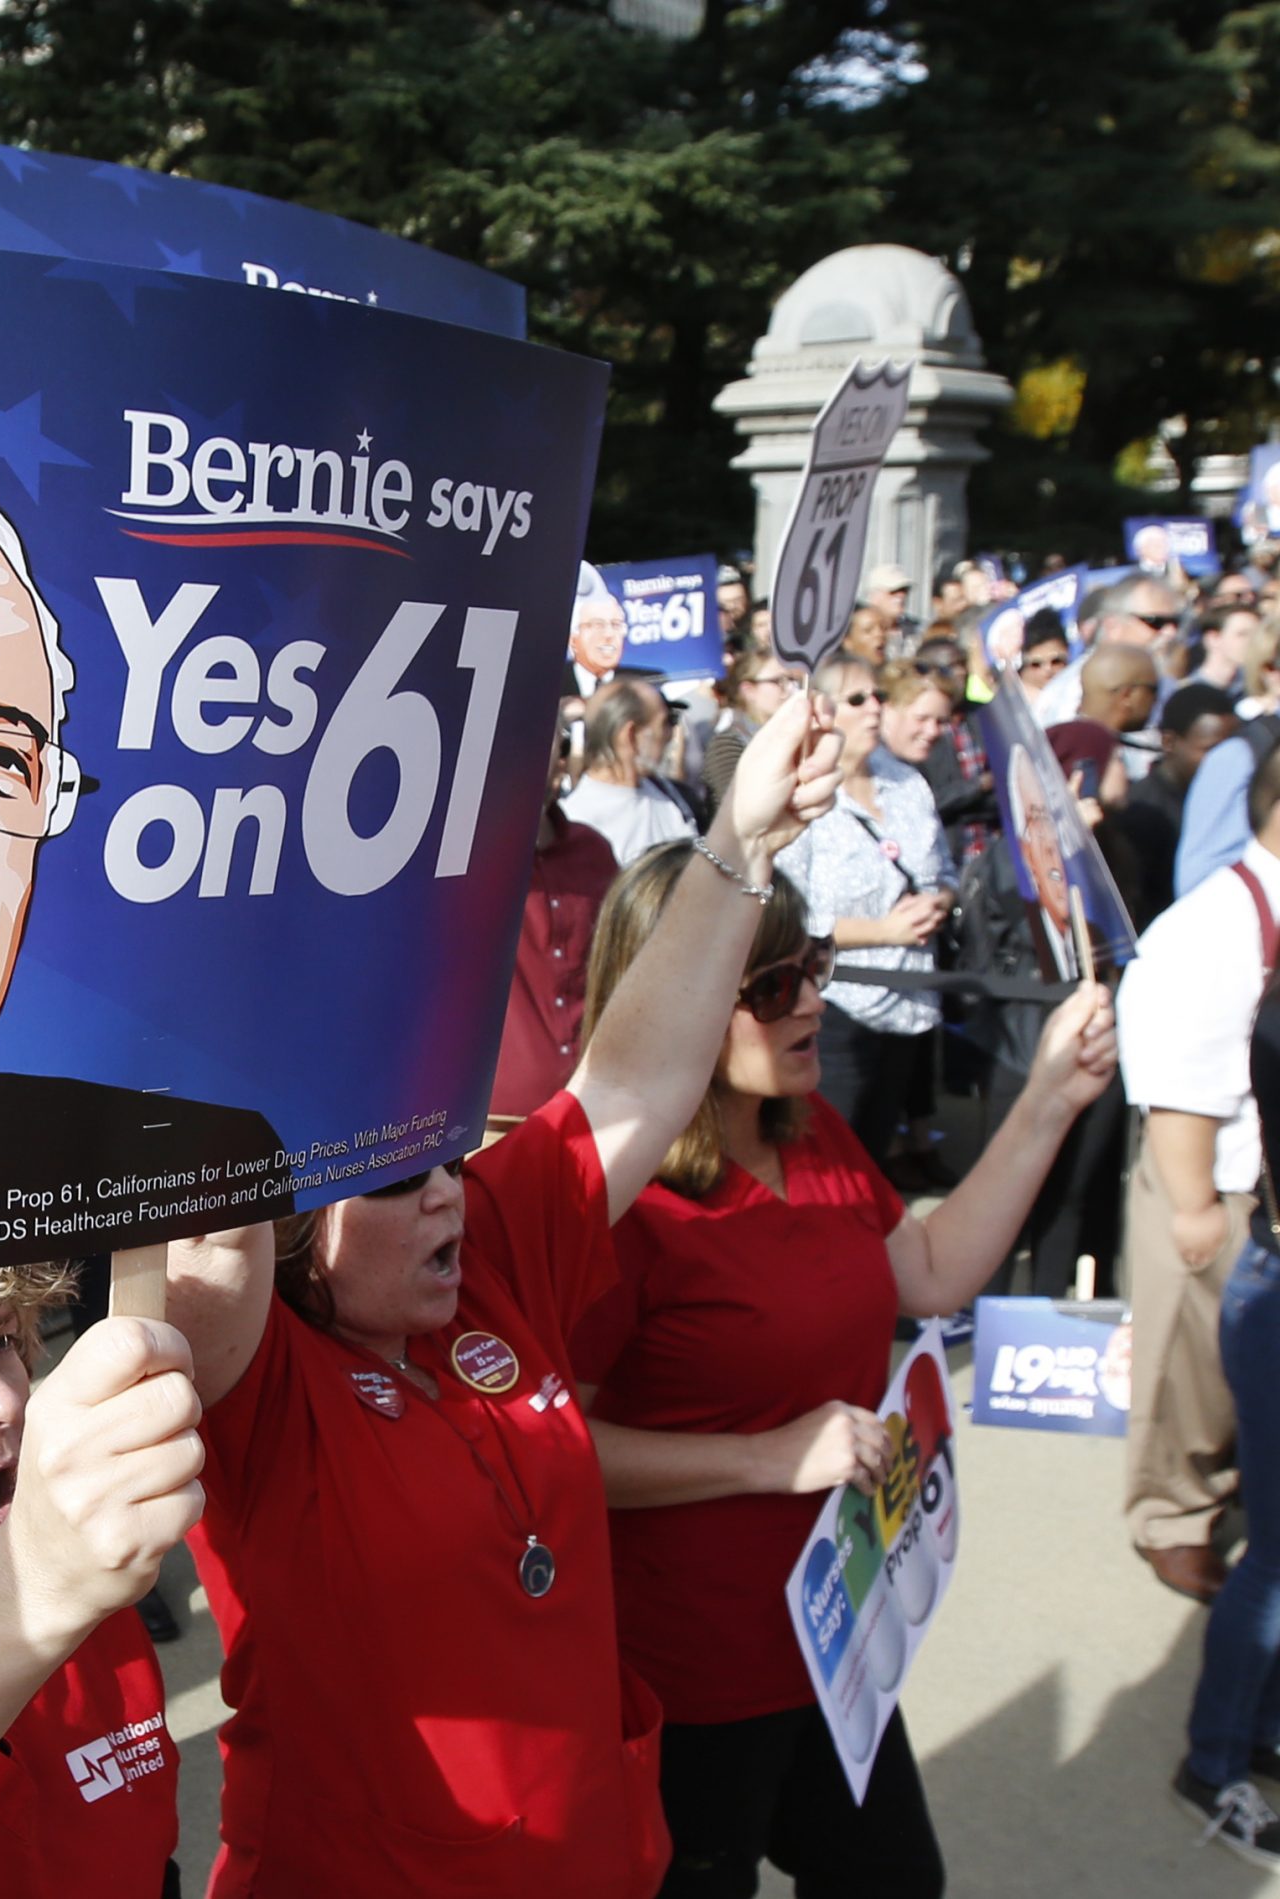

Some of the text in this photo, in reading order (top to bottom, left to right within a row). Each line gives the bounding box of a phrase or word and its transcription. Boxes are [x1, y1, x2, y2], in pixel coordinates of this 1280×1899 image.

[121, 409, 534, 556] Bernie says
[809, 471, 867, 523] PROP
[623, 598, 663, 624] Yes
[628, 623, 661, 645] on
[661, 591, 705, 642] 61
[792, 520, 849, 647] 61
[93, 576, 327, 755] Yes
[301, 600, 520, 896] 61
[103, 784, 287, 904] on
[7, 1188, 54, 1211] Prop
[60, 1183, 90, 1204] 61,
[97, 1169, 196, 1199] Californians
[200, 1163, 221, 1183] for
[225, 1157, 270, 1179] Lower
[274, 1149, 306, 1169] Drug
[310, 1139, 350, 1161] Prices,
[354, 1130, 379, 1149] With
[381, 1121, 410, 1143] Major
[410, 1109, 447, 1131] Funding
[34, 1210, 133, 1237] Healthcare
[138, 1192, 226, 1222] Foundation
[230, 1182, 258, 1205] and
[261, 1172, 322, 1197] California
[325, 1158, 365, 1182] Nurses
[422, 1130, 444, 1152] PAC
[990, 1344, 1056, 1394] 61
[808, 1537, 853, 1628] Nurses
